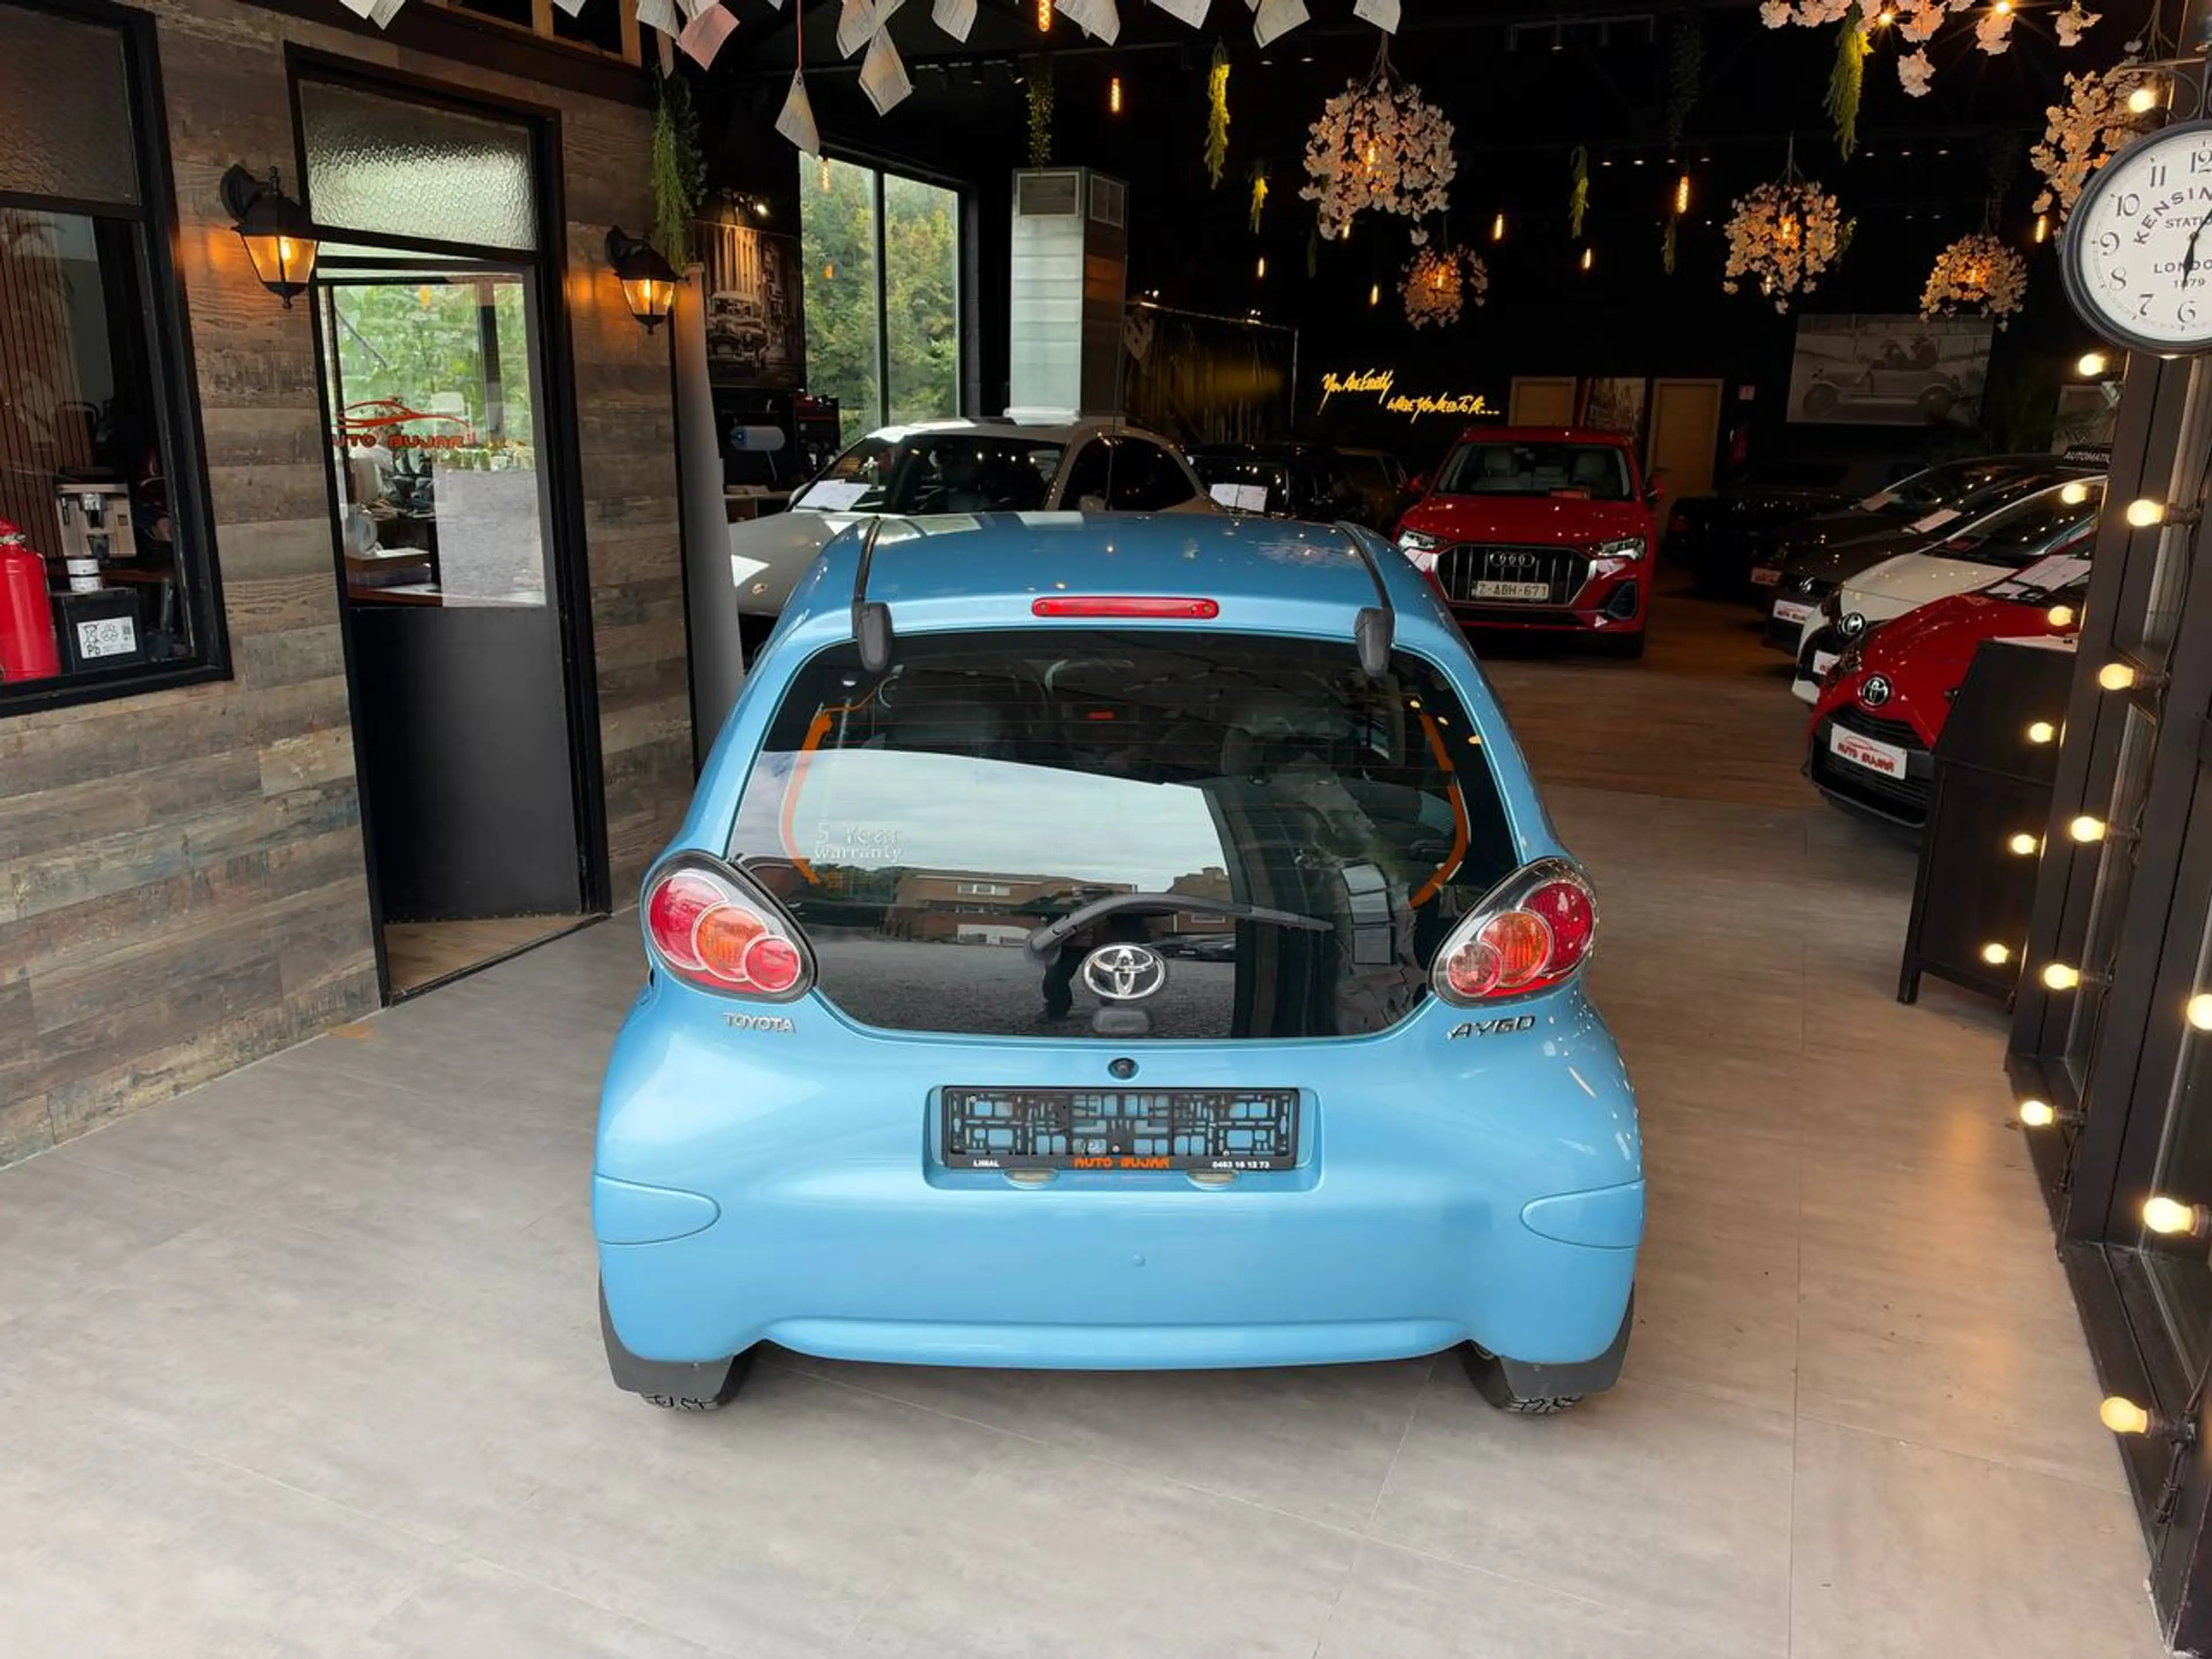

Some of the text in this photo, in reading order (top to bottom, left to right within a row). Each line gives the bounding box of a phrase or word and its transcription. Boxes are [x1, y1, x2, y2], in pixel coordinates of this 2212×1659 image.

[2191, 150, 2212, 173] 12
[2150, 165, 2166, 188] 11
[2116, 194, 2141, 217] 10
[2100, 232, 2120, 256] 9
[2109, 266, 2127, 290] 8
[2173, 277, 2206, 289] 179
[2138, 294, 2154, 316] 7
[2177, 300, 2196, 324] 6
[722, 1012, 797, 1034] TOYOTA
[1446, 1016, 1535, 1040] AYGO
[1074, 1156, 1171, 1169] AUTO BUJAR
